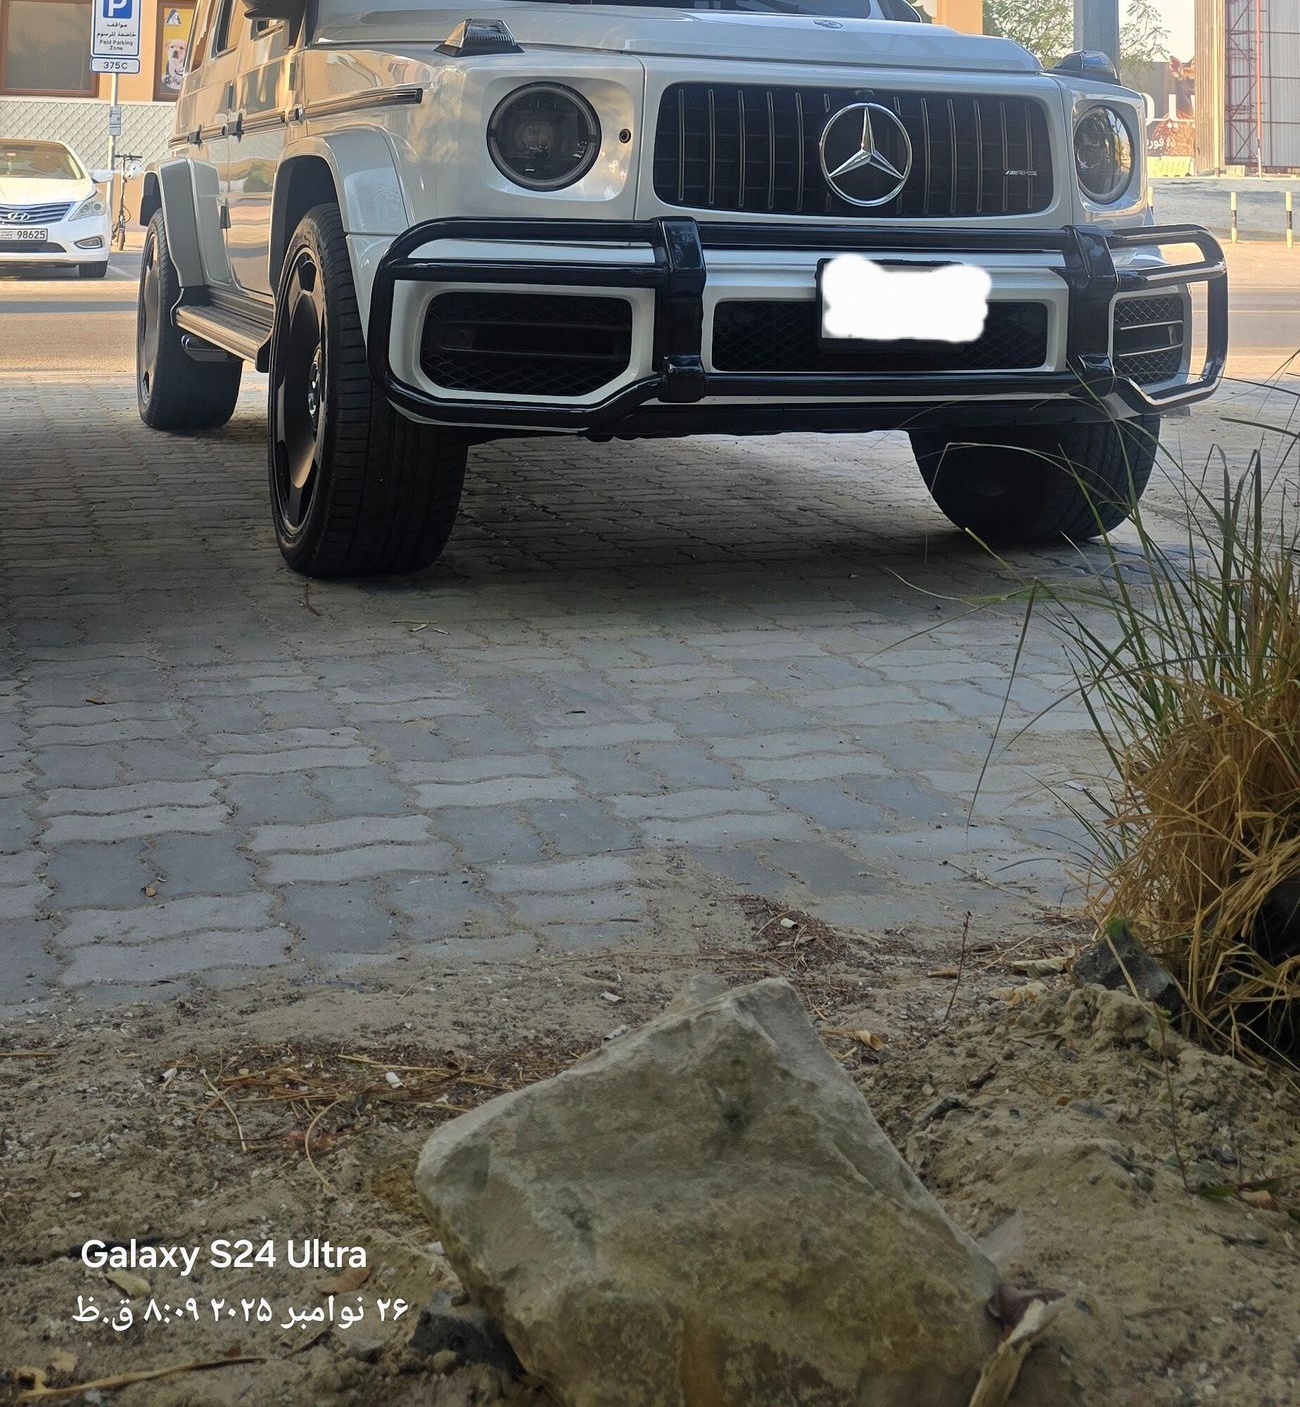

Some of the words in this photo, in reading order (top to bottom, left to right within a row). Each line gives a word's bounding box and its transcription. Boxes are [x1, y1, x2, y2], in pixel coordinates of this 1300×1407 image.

[107, 21, 127, 29] مواقف
[103, 61, 128, 70] 375C
[16, 230, 46, 240] 98625
